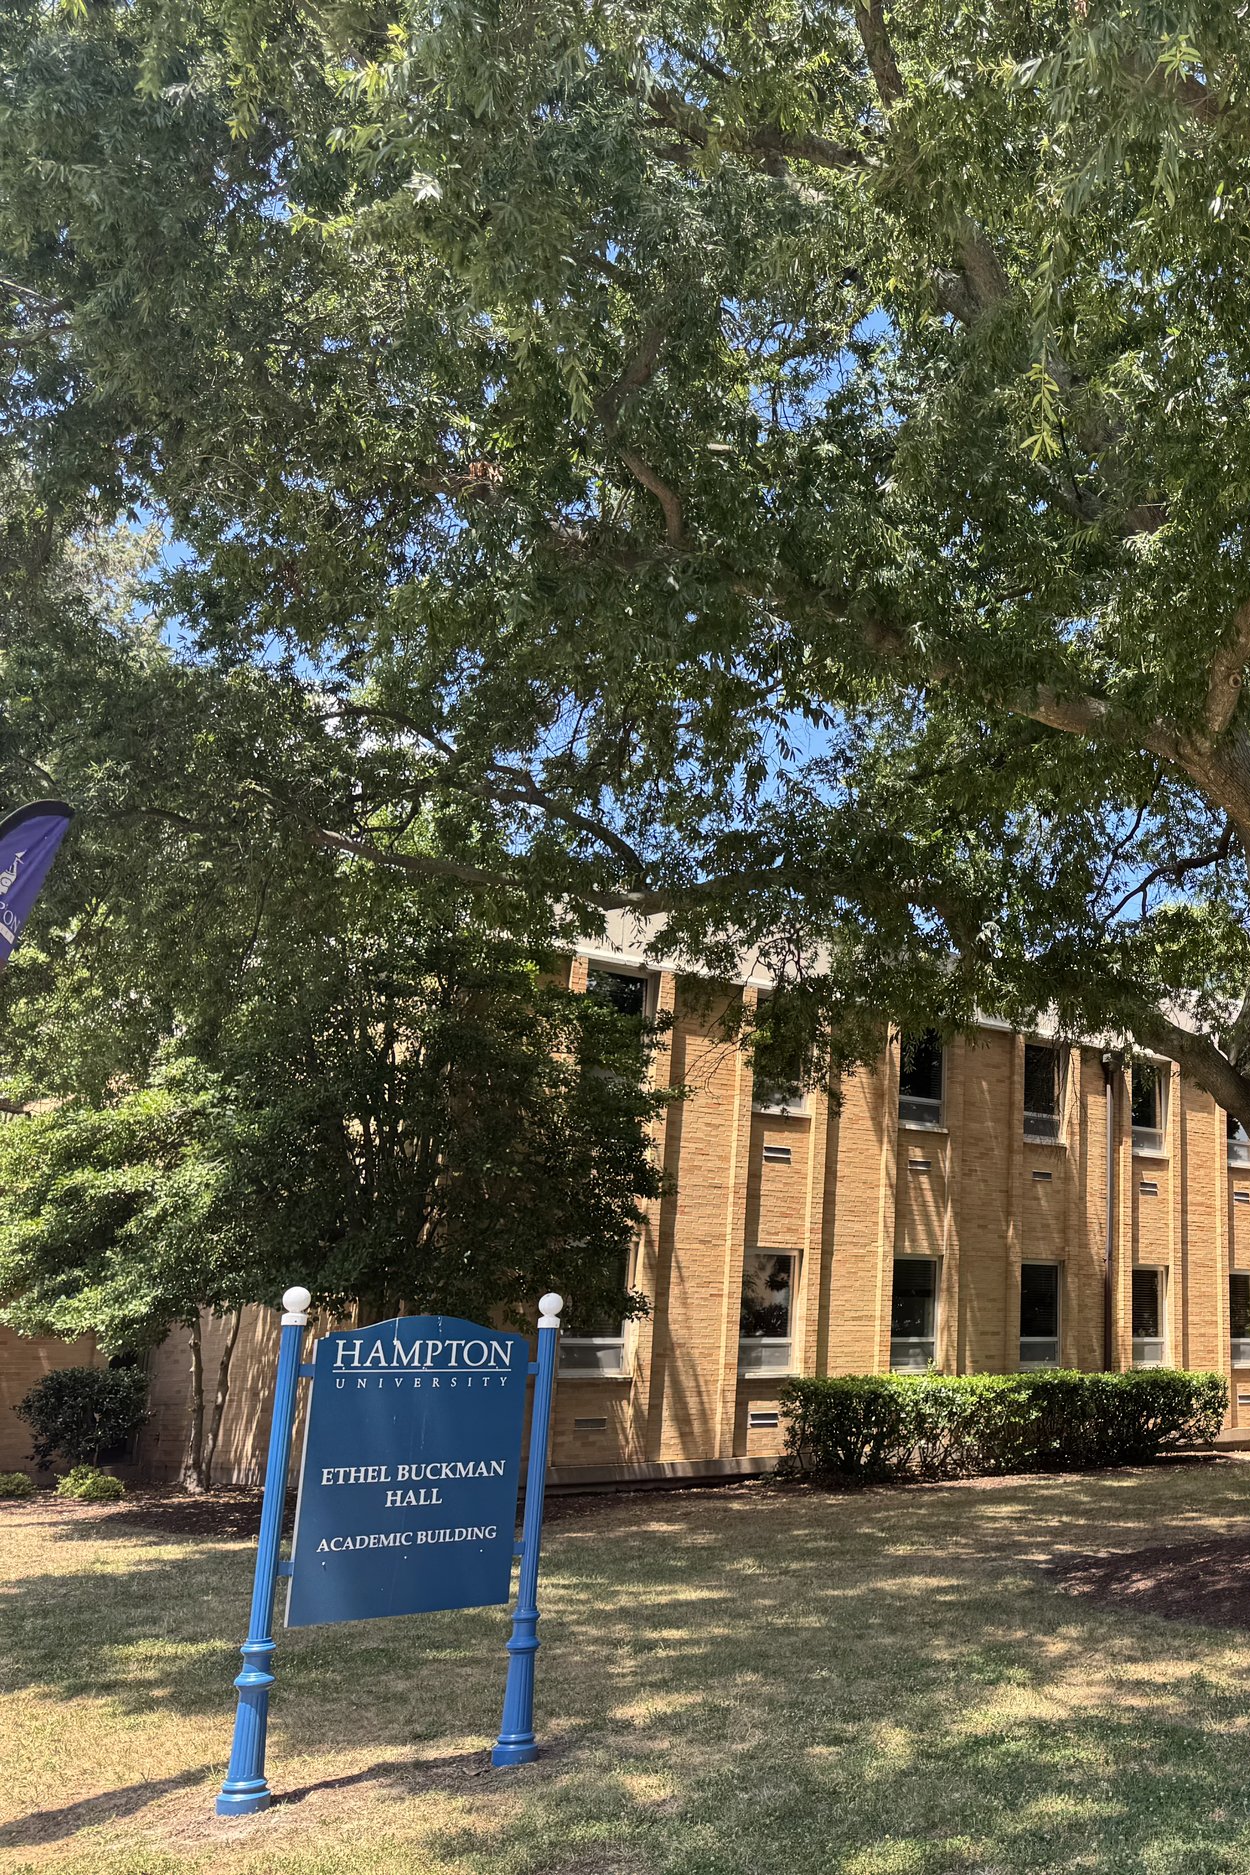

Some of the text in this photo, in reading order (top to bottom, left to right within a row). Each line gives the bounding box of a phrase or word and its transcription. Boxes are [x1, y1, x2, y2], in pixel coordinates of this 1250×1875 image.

[333, 1339, 515, 1367] HAMPTON
[336, 1376, 508, 1389] UNIVERSITY
[321, 1460, 506, 1485] ETHEL BUCKMAN
[384, 1488, 443, 1507] HALL
[316, 1526, 497, 1552] ACADEMIC BUILDING
